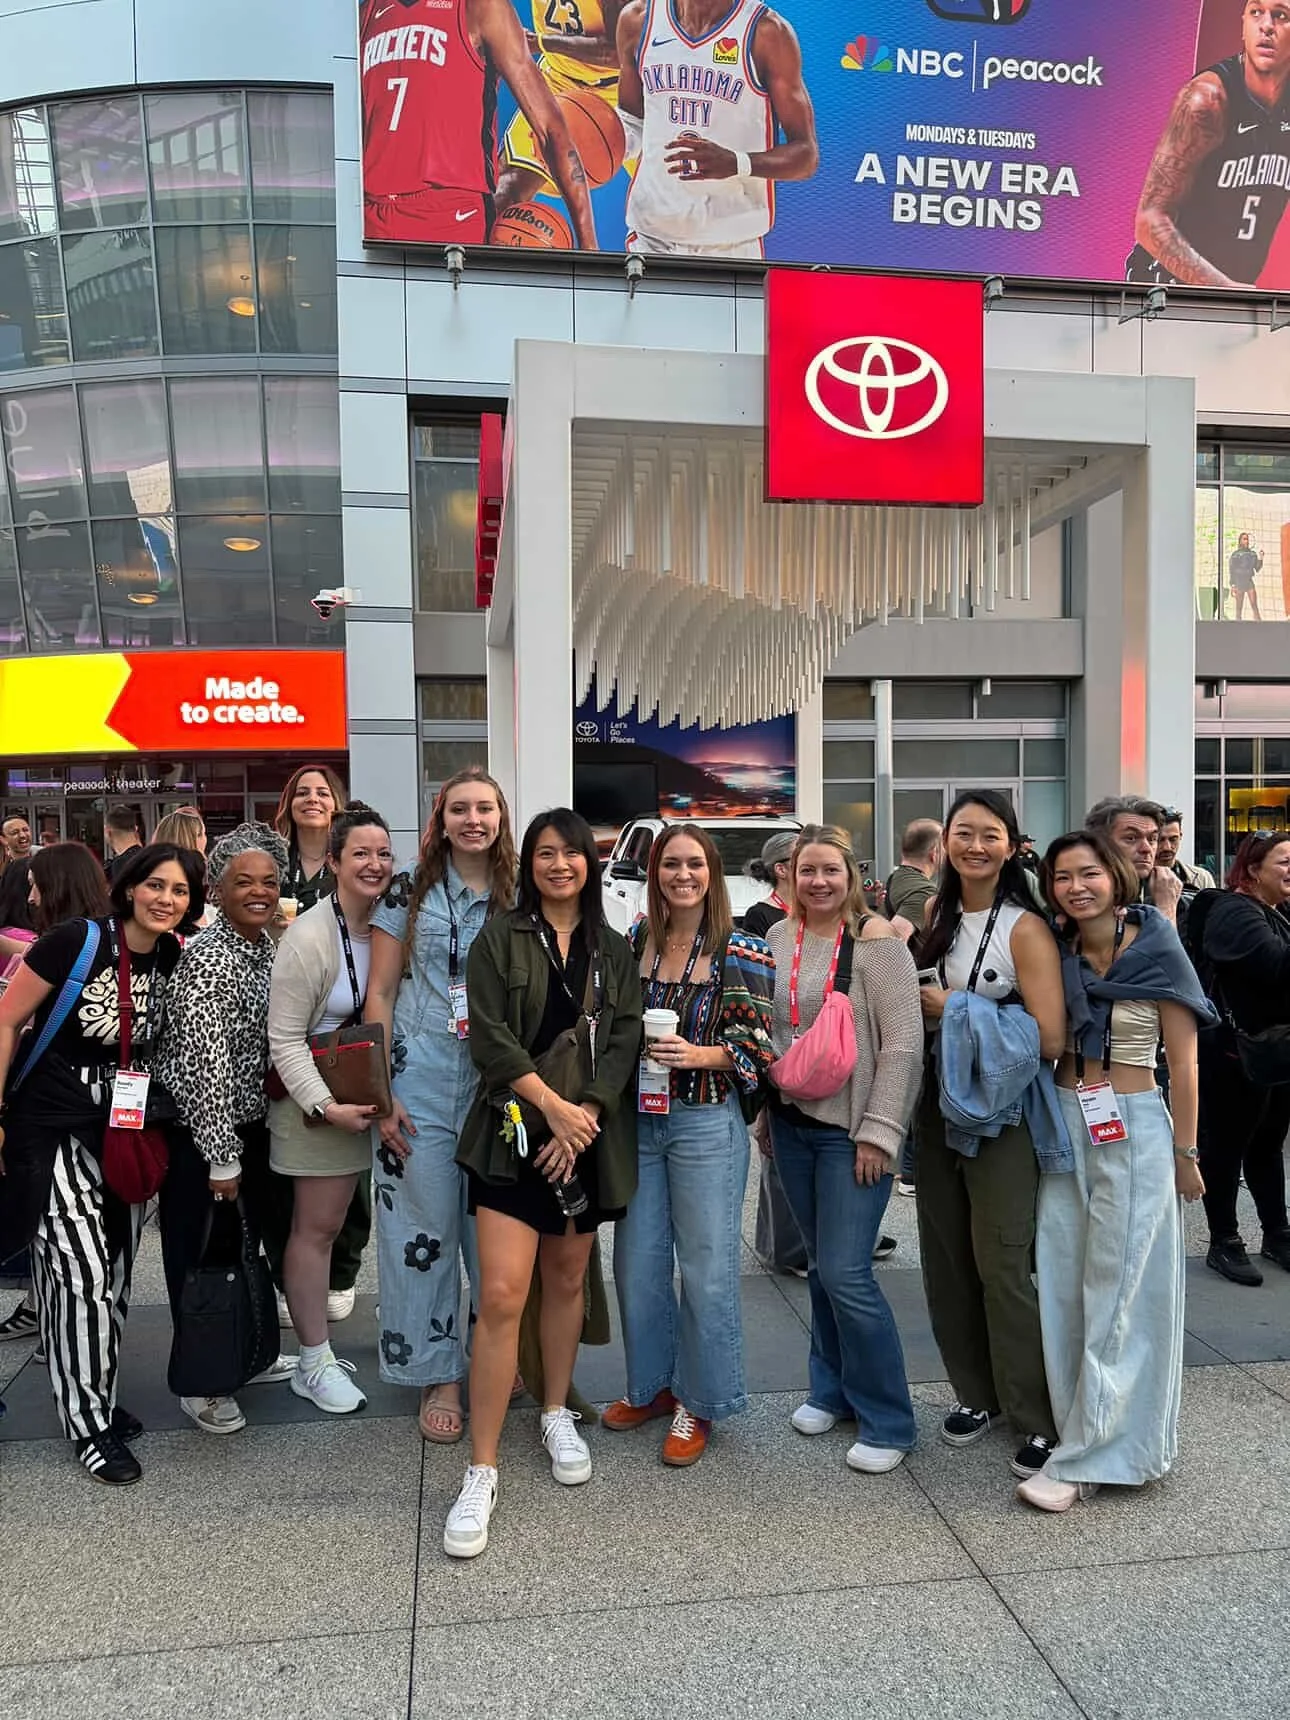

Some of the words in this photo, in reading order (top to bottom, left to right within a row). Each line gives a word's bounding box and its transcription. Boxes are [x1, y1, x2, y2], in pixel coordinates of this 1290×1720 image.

[363, 24, 449, 76] ROCKETS
[643, 64, 744, 103] OKLAHOMA
[896, 47, 964, 79] NBC
[983, 55, 1103, 90] peacock
[387, 77, 409, 131] 7
[668, 97, 712, 127] CITY
[906, 123, 966, 147] MONDAYS
[967, 128, 976, 146] &
[978, 129, 1035, 150] TUESDAYS
[854, 153, 885, 185] A
[897, 156, 992, 192] NEW
[1001, 163, 1081, 198] ERA
[503, 207, 555, 238] Wilson
[893, 193, 1042, 232] BEGINS
[1238, 195, 1261, 240] 5
[205, 677, 279, 700] Made
[181, 703, 208, 724] to
[213, 702, 305, 724] create.
[610, 721, 628, 729] Let's
[611, 736, 635, 744] Places
[64, 777, 111, 795] peacock
[116, 778, 161, 790] theater
